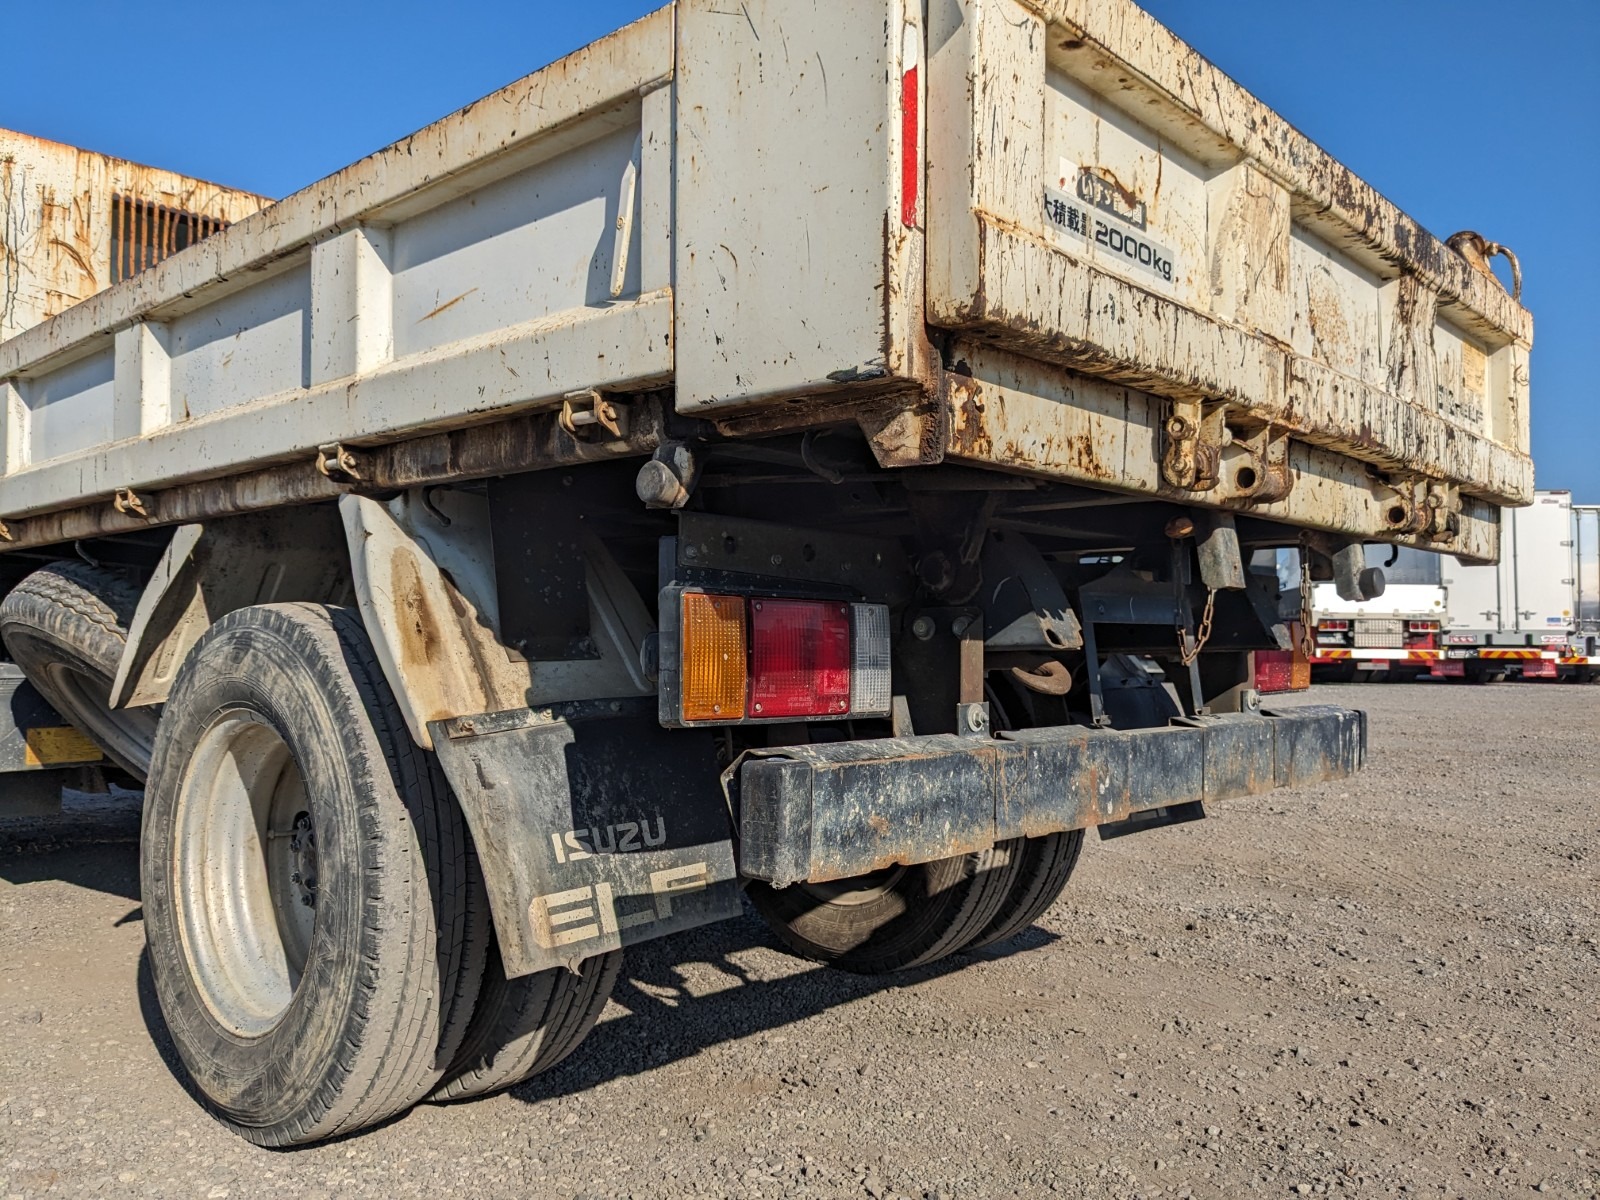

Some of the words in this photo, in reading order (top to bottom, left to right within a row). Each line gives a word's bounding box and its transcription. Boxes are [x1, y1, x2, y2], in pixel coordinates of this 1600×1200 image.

[1095, 220, 1172, 282] 2000kg
[551, 817, 667, 864] ISUZU
[528, 862, 706, 949] ELF
